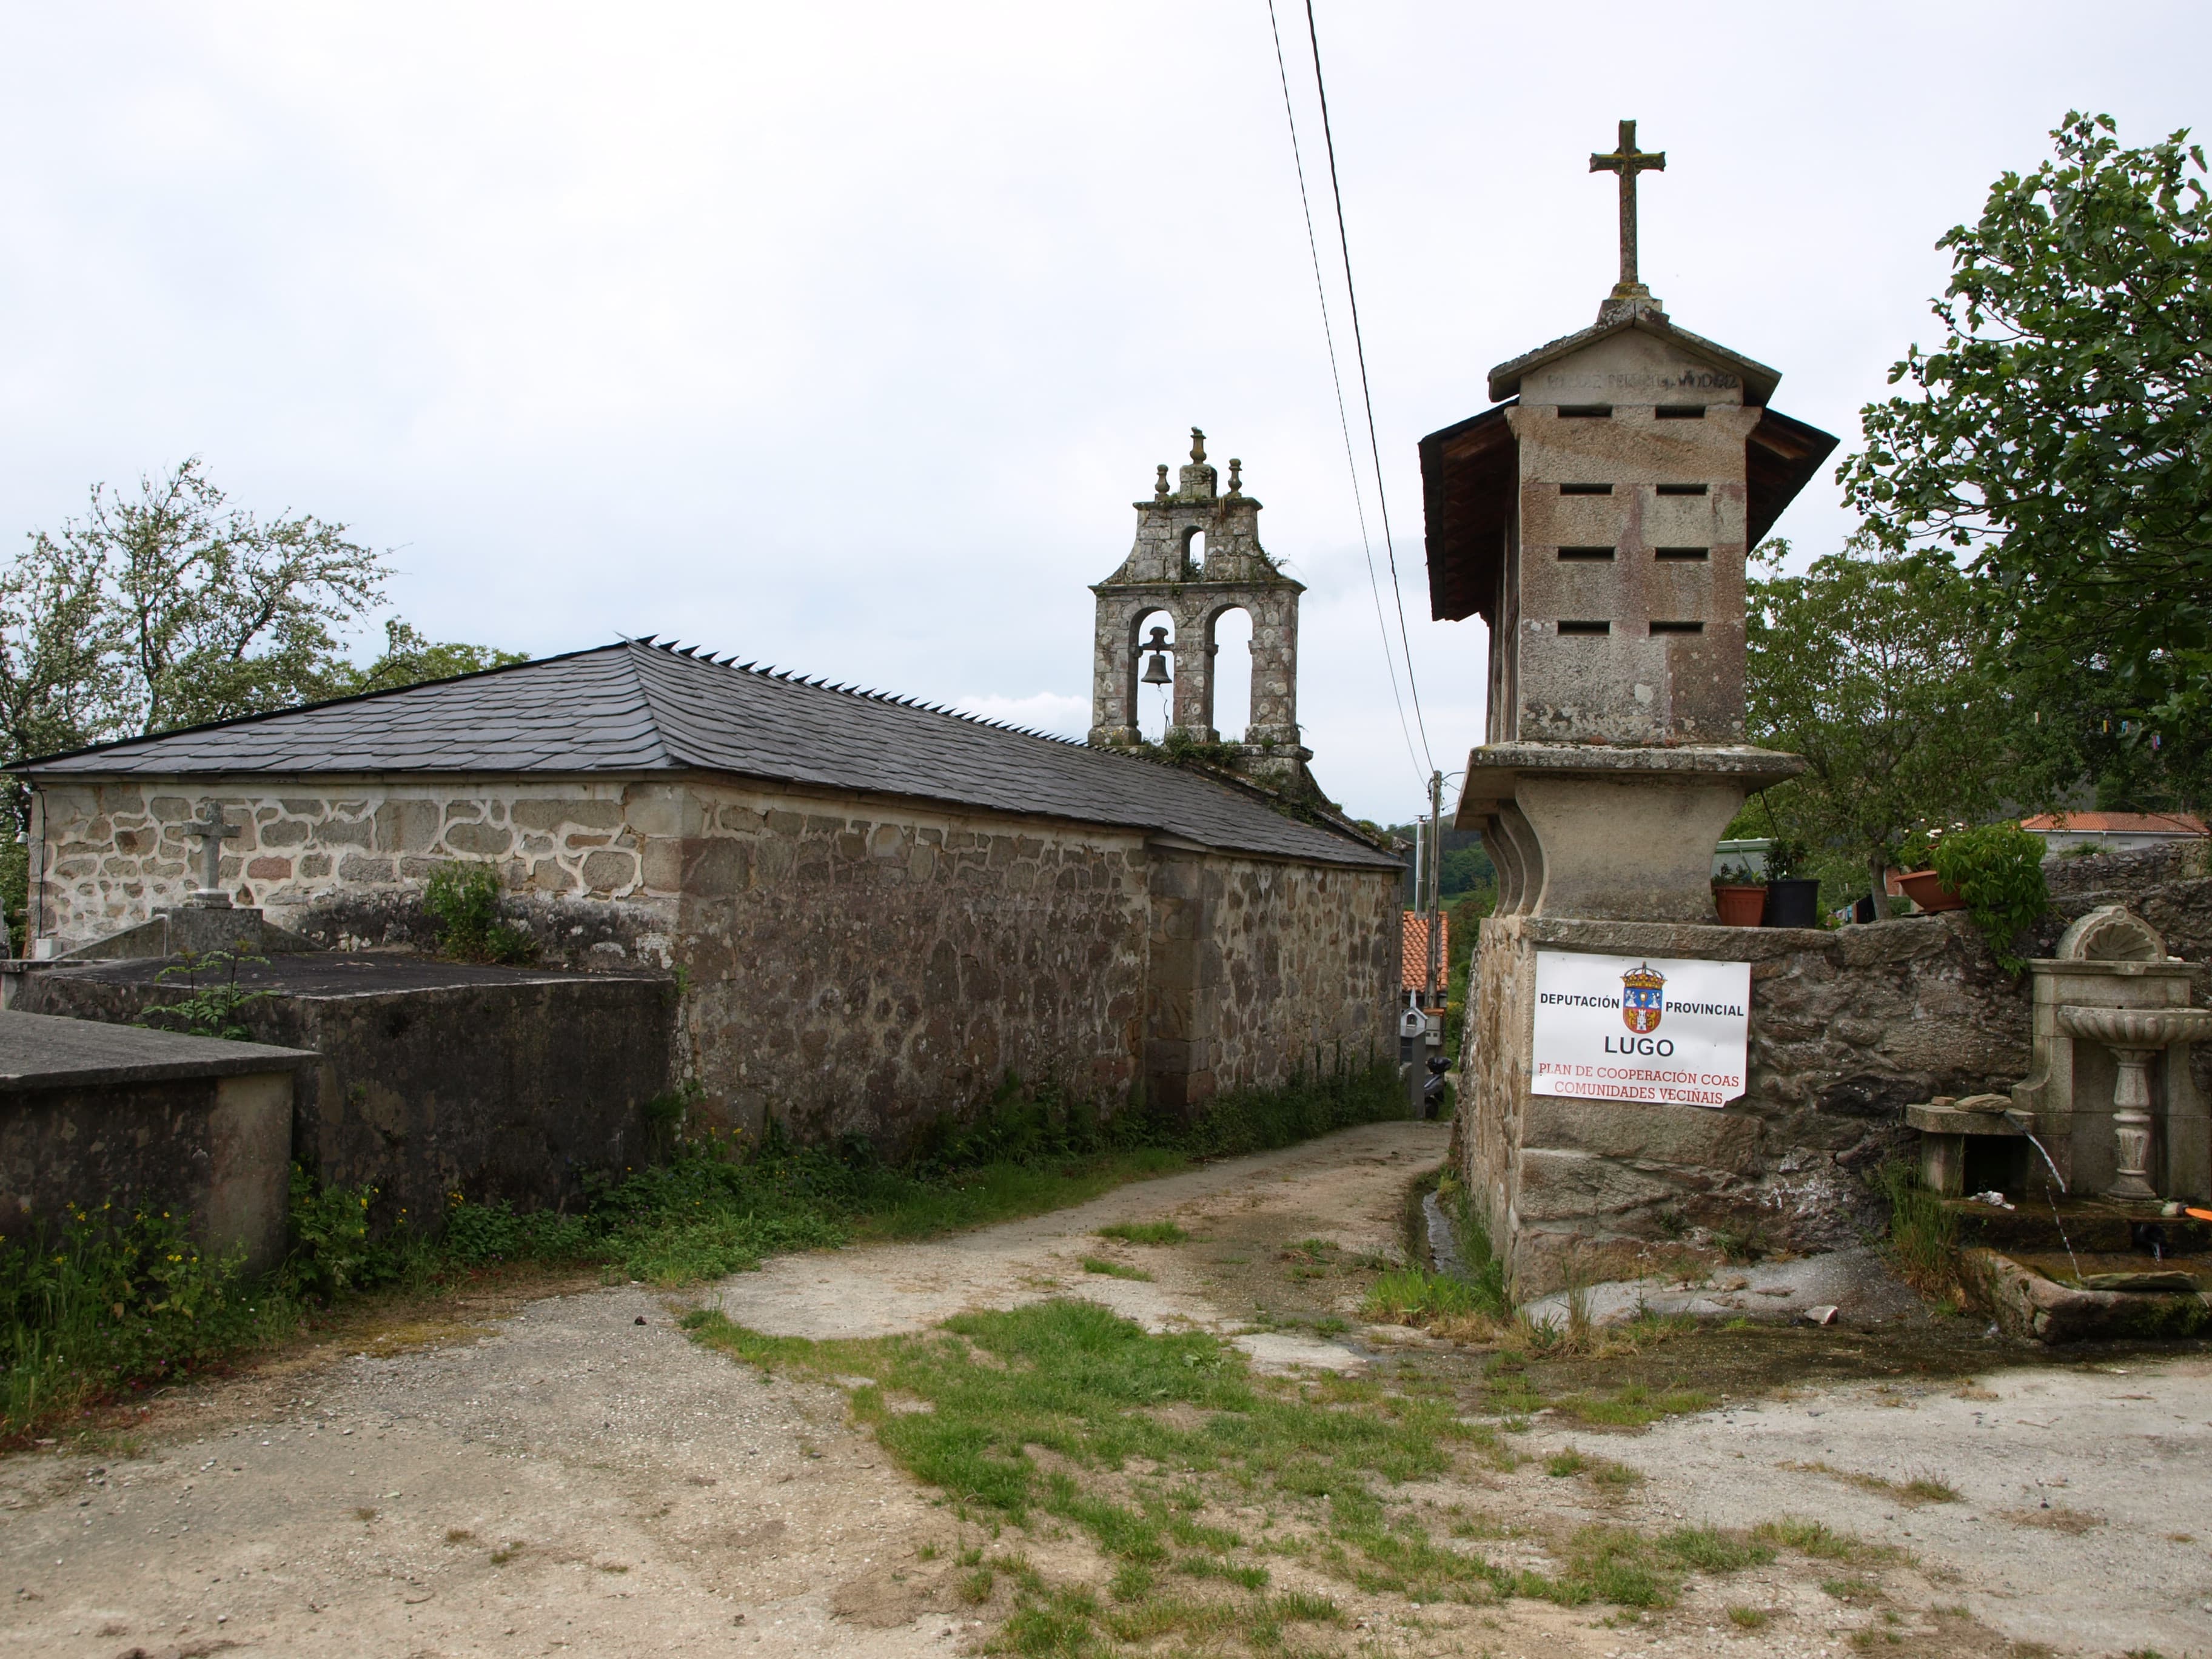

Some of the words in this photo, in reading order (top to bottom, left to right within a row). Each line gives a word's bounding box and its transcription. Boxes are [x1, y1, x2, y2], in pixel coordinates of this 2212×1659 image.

[1541, 993, 1620, 1009] DEPUTACIÓN
[1666, 1002, 1744, 1016] PROVINCIAL
[1604, 1036, 1674, 1057] LUGO
[1539, 1063, 1571, 1076] PLAN
[1576, 1065, 1593, 1077] DE
[1597, 1067, 1697, 1084] COOPERACIÓN
[1701, 1074, 1739, 1087] COAS
[1555, 1081, 1655, 1099] COMUNIDADES
[1659, 1088, 1723, 1104] VECIÑAIS
